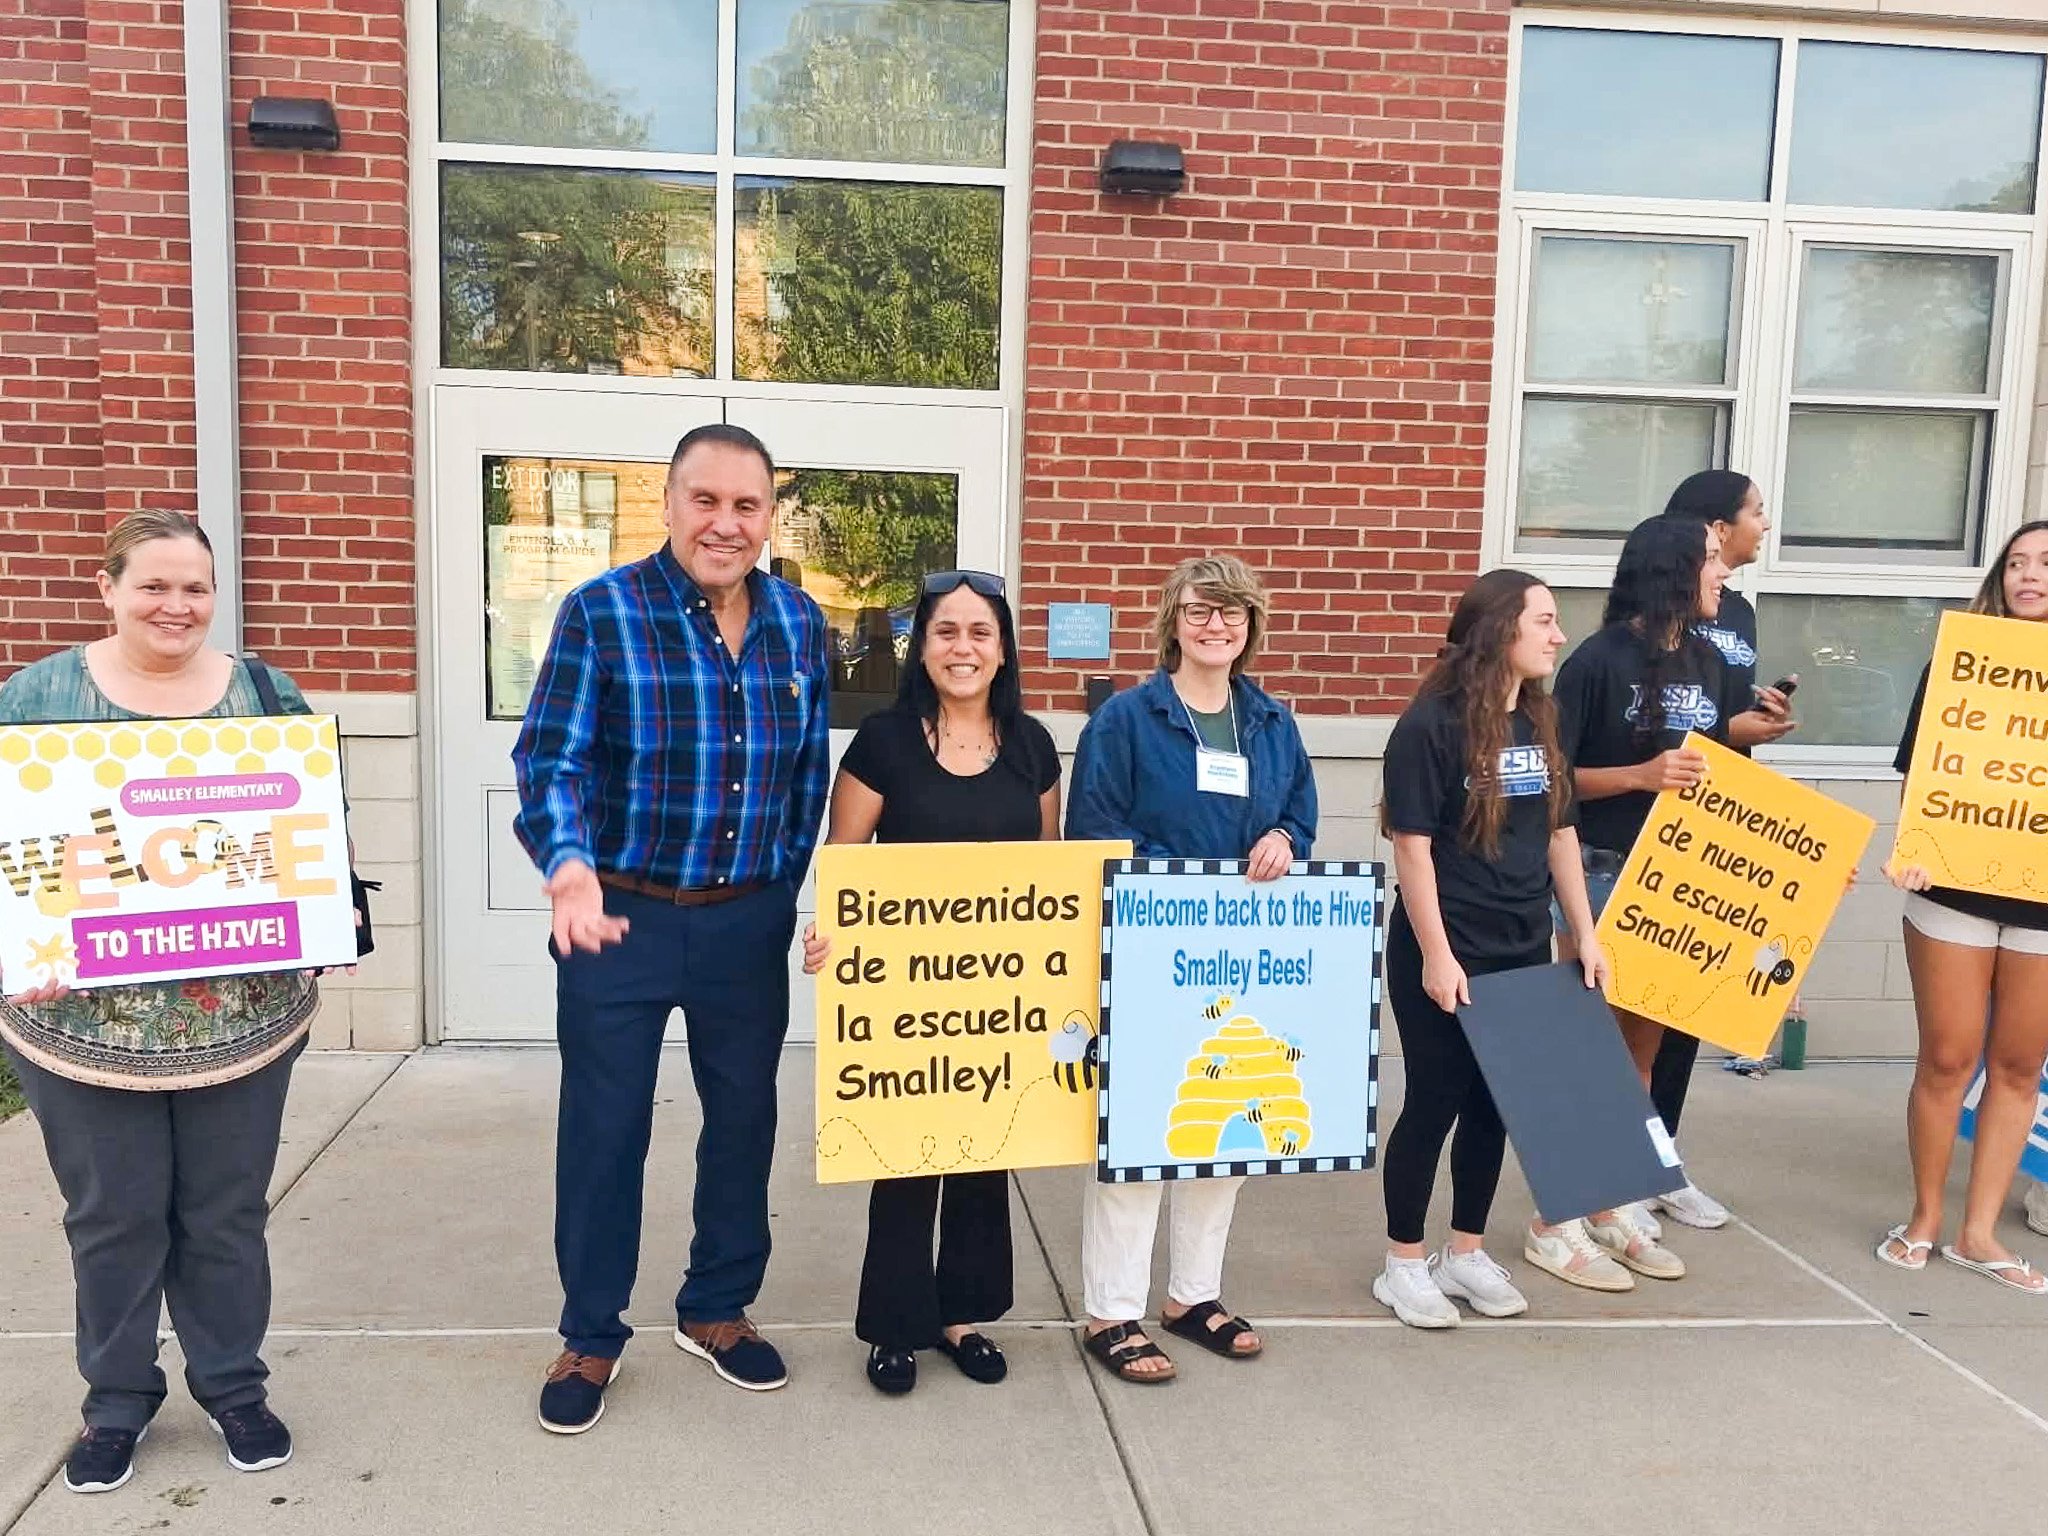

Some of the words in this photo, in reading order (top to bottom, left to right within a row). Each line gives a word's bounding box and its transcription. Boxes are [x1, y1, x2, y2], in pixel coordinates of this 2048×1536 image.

[492, 465, 525, 490] EXT
[529, 466, 579, 491] DOOR
[509, 535, 563, 546] EXTEND
[1941, 698, 1987, 731] de
[2006, 713, 2048, 741] nu
[1932, 741, 1965, 775] la
[1983, 758, 2048, 787] esc
[130, 787, 195, 804] SMALLEY
[195, 782, 284, 800] ELEMENTARY
[1921, 790, 2048, 835] Smalle
[1678, 779, 1828, 863] Bienvenidos
[1658, 818, 1693, 852] de
[1701, 840, 1774, 890] nuevo
[1782, 880, 1800, 902] a
[837, 884, 1080, 927] Bienvenidos
[1116, 888, 1208, 927] Welcome
[1215, 890, 1261, 927] back
[1267, 894, 1287, 927] to
[1292, 890, 1323, 927] the
[1329, 890, 1373, 927] Hive
[1637, 857, 1664, 893] la
[1673, 882, 1768, 938] escuela
[87, 930, 129, 960] TO
[135, 924, 196, 956] THE
[201, 916, 287, 952] HIVE!
[1616, 904, 1732, 974] Smalley!
[836, 945, 886, 985] de
[909, 952, 1025, 982] nuevo
[1045, 950, 1068, 977] a
[1173, 948, 1251, 995] Smalley
[1258, 948, 1313, 985] Bees!
[837, 1003, 872, 1043] la
[894, 995, 1048, 1039] escuela
[836, 1051, 1012, 1103] Smalley!
